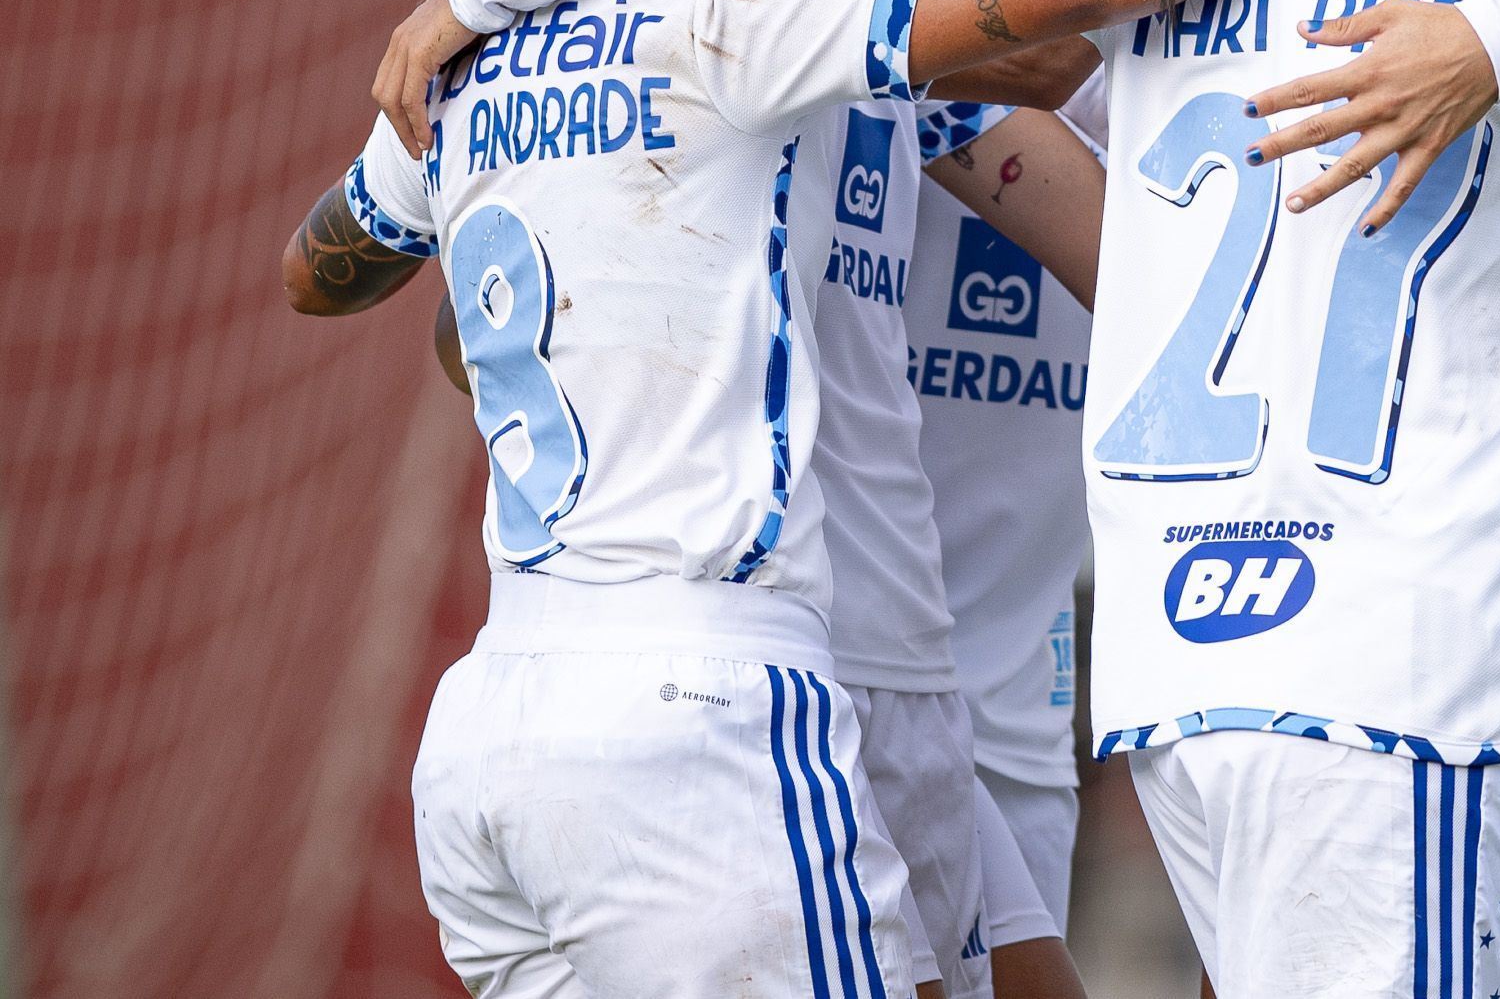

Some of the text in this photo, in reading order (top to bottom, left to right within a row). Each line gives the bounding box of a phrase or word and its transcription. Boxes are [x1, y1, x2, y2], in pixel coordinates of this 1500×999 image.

[468, 77, 675, 175] ANDRADE
[450, 199, 588, 567] 8
[1163, 521, 1335, 543] SUPERMERCADOS
[1174, 557, 1303, 623] BH
[682, 691, 731, 708] AEROREADY
